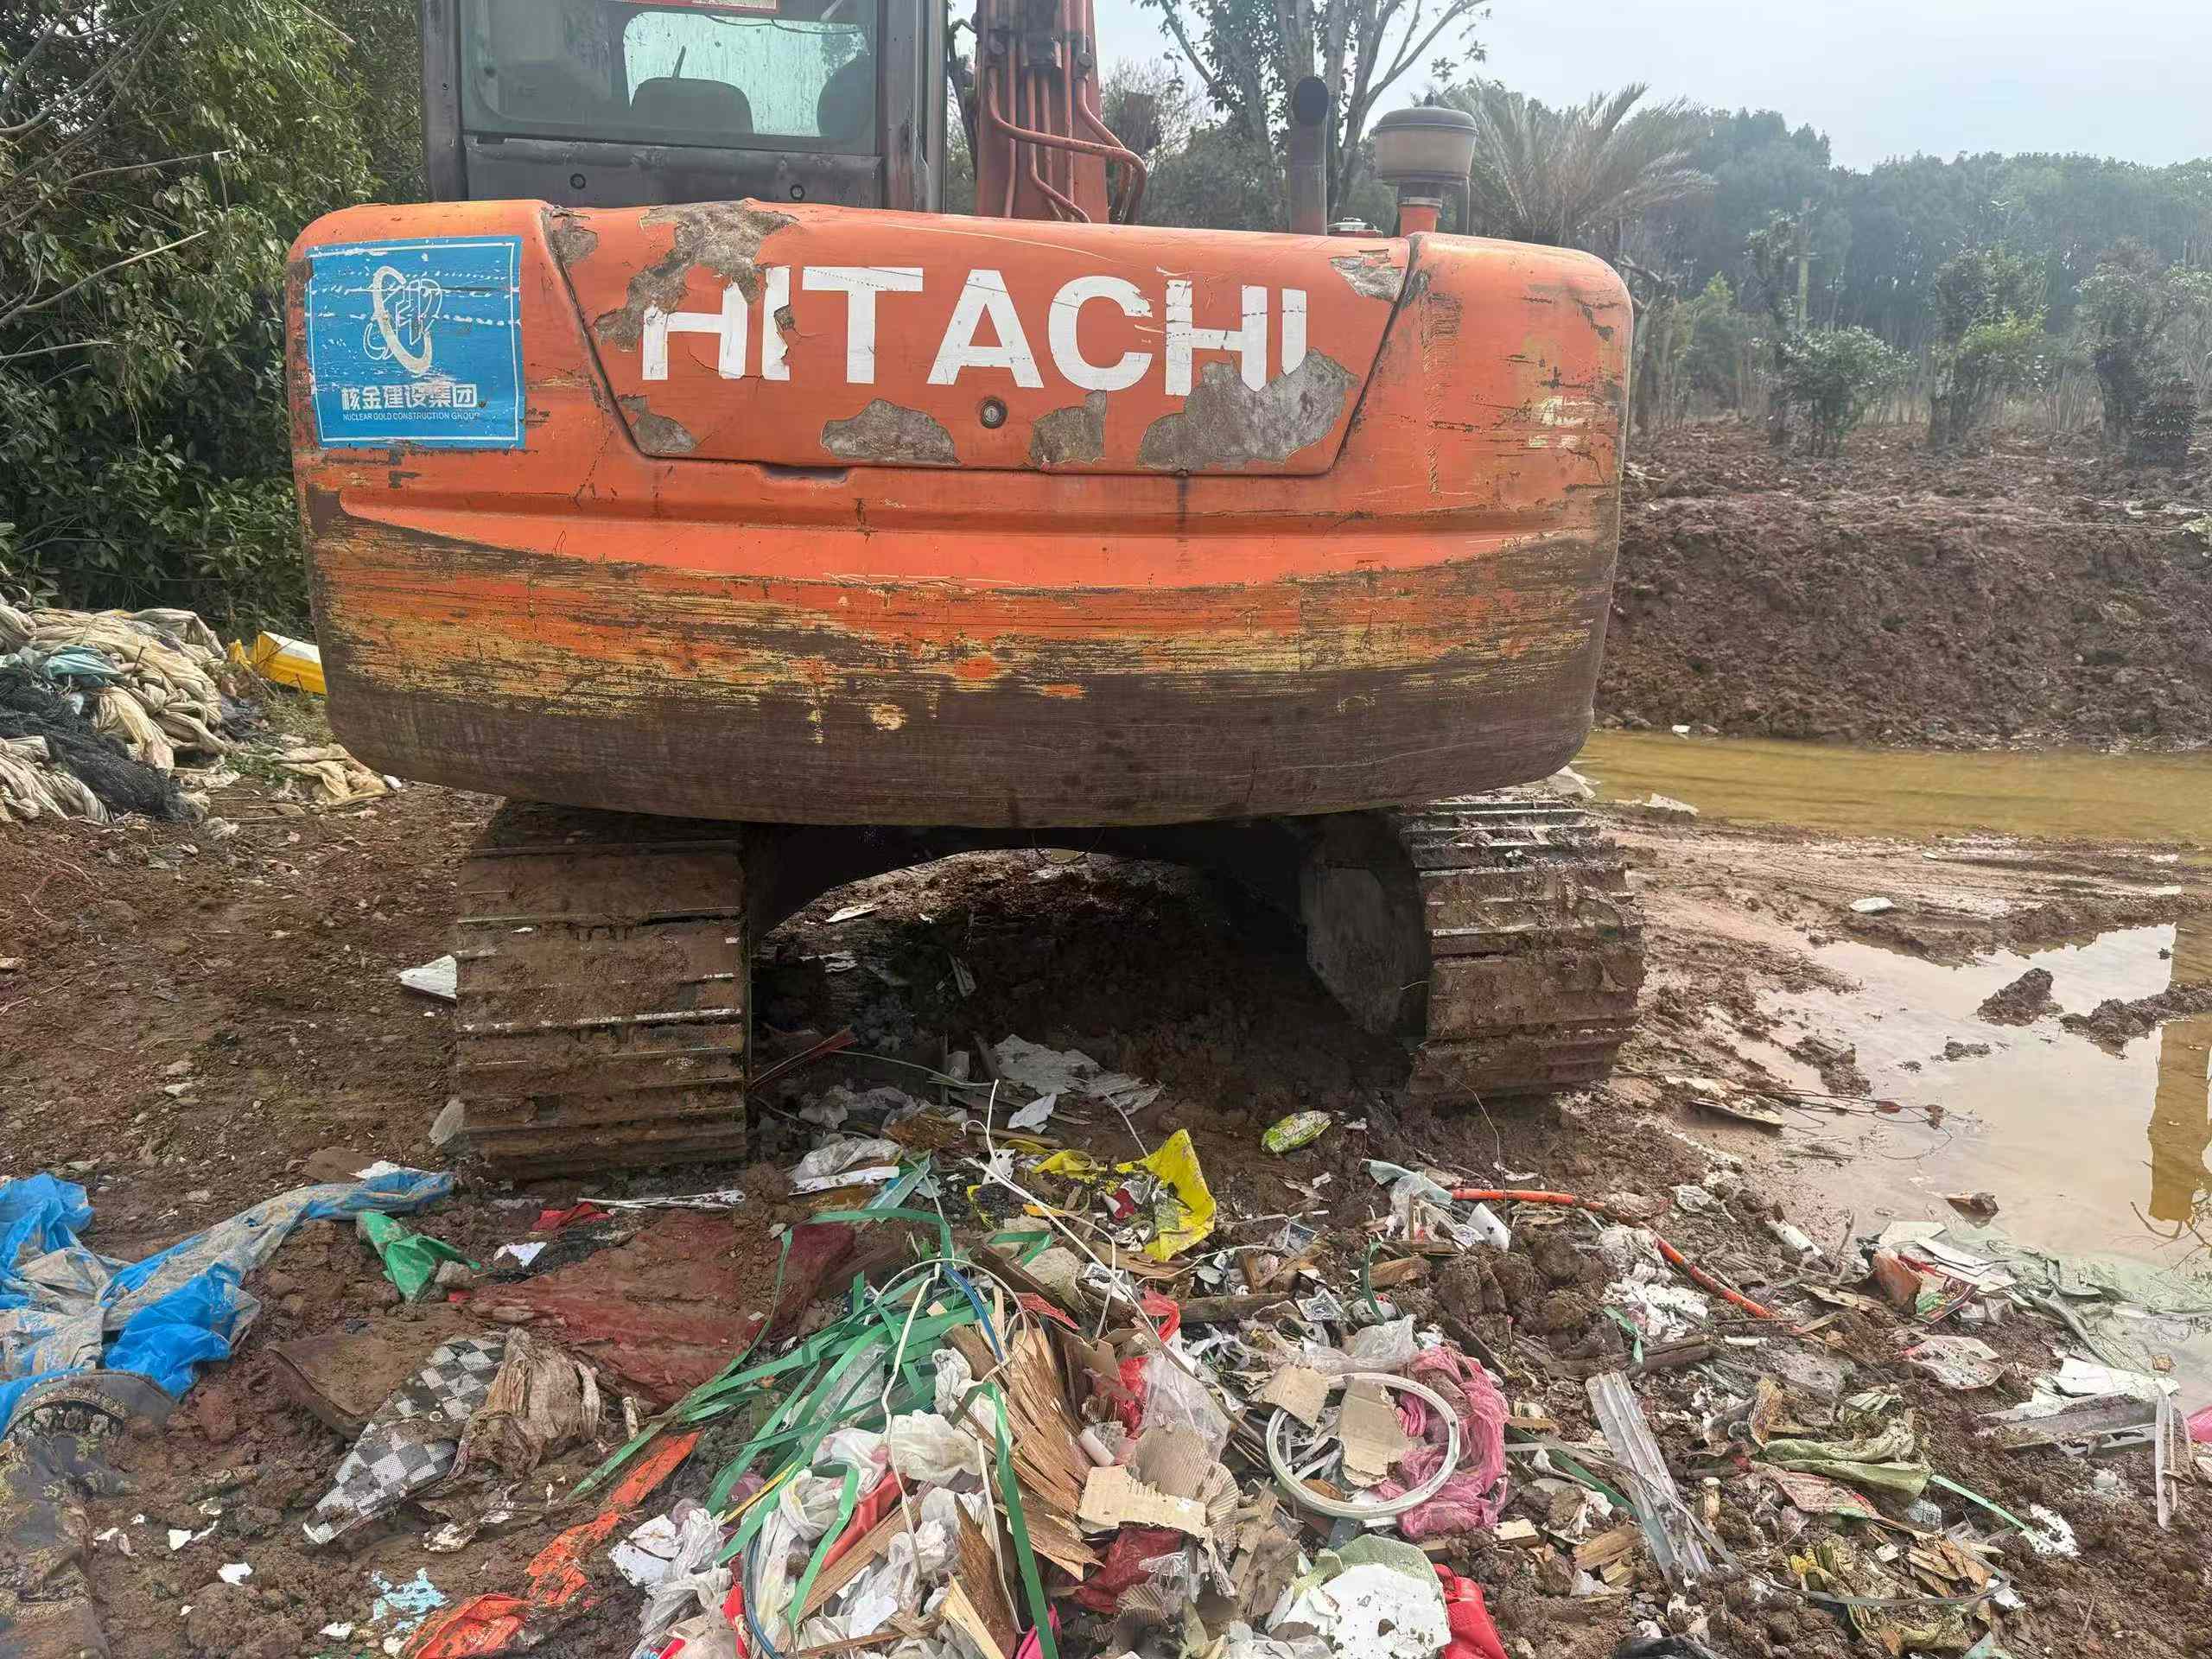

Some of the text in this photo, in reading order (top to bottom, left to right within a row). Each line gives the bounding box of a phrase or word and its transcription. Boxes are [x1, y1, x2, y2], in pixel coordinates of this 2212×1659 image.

[642, 266, 1306, 396] HITACHI
[343, 412, 372, 422] NUCLEAR
[373, 412, 392, 421] GOLD
[393, 412, 450, 421] CONSTRUCTION
